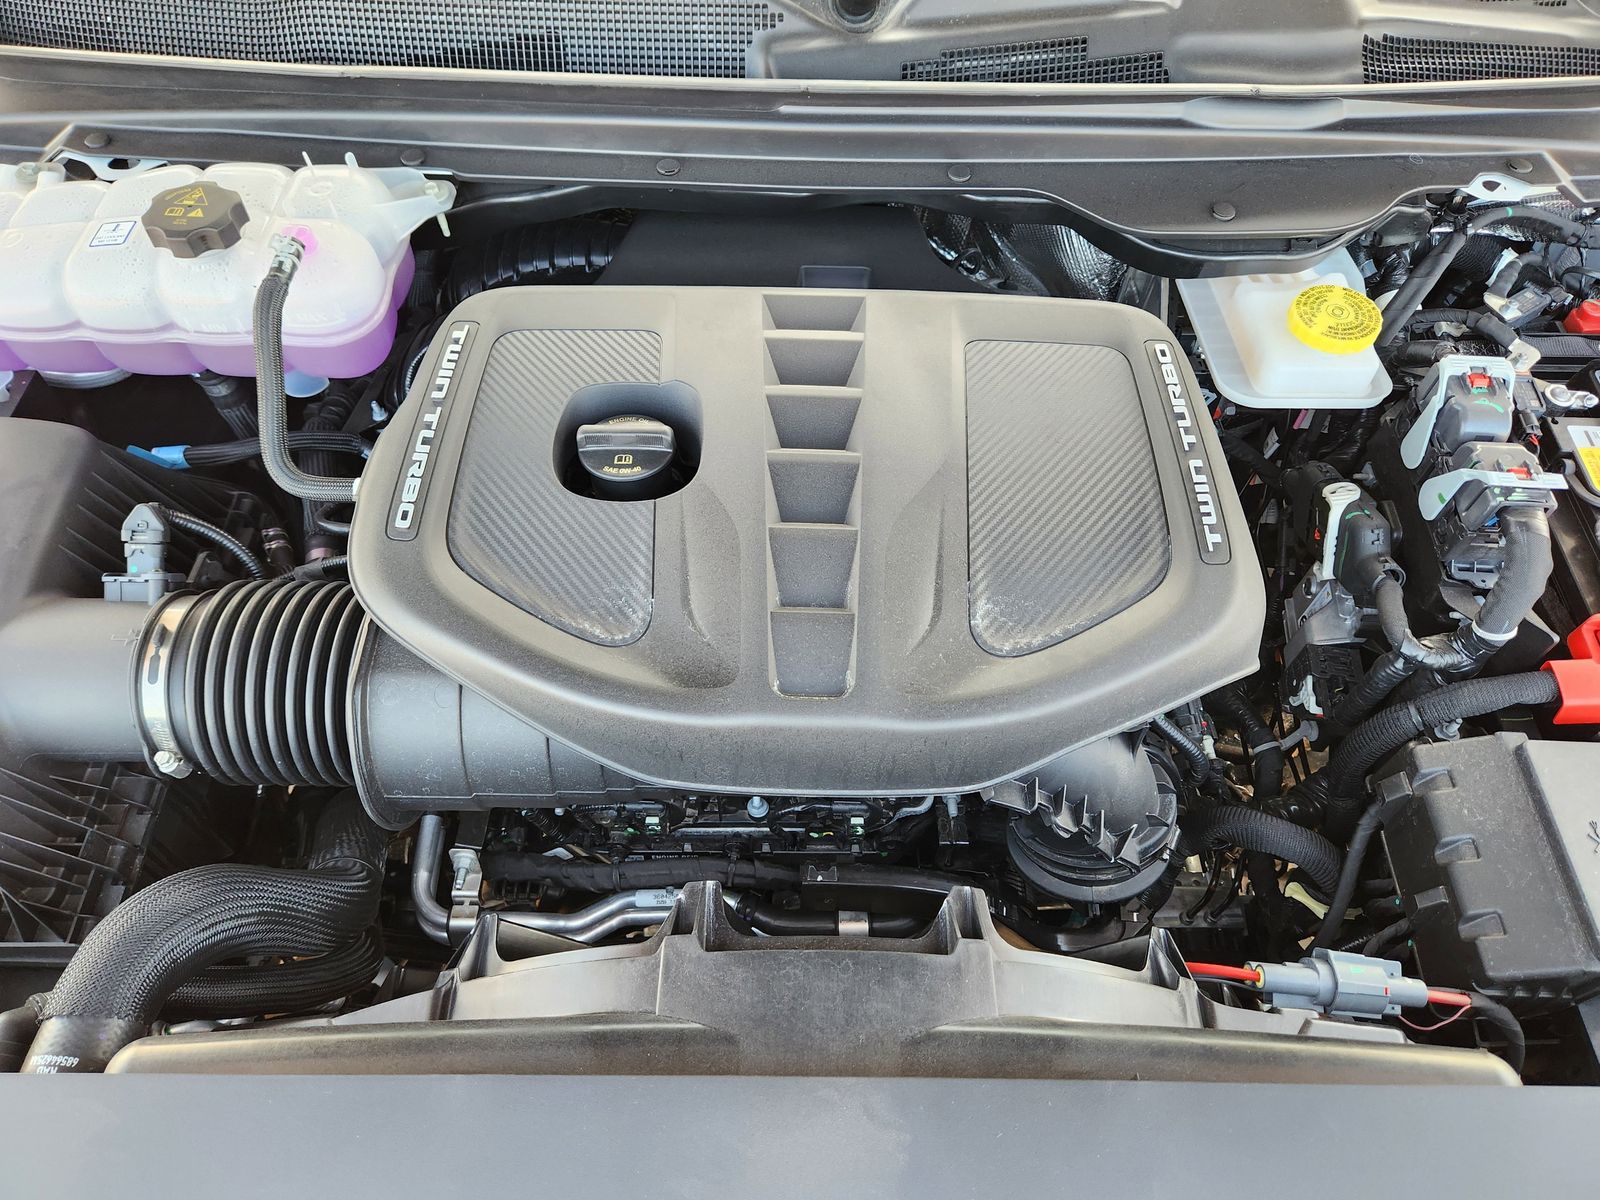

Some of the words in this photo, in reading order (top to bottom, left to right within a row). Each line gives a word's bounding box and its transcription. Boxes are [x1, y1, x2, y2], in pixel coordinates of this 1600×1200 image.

[431, 325, 469, 398] TWIN
[1154, 343, 1197, 451] TURBO
[608, 416, 636, 425] ENGINE
[395, 406, 442, 529] TURBO
[602, 465, 618, 474] SAE
[619, 465, 642, 474] 0W-40
[1188, 459, 1222, 552] TWIN
